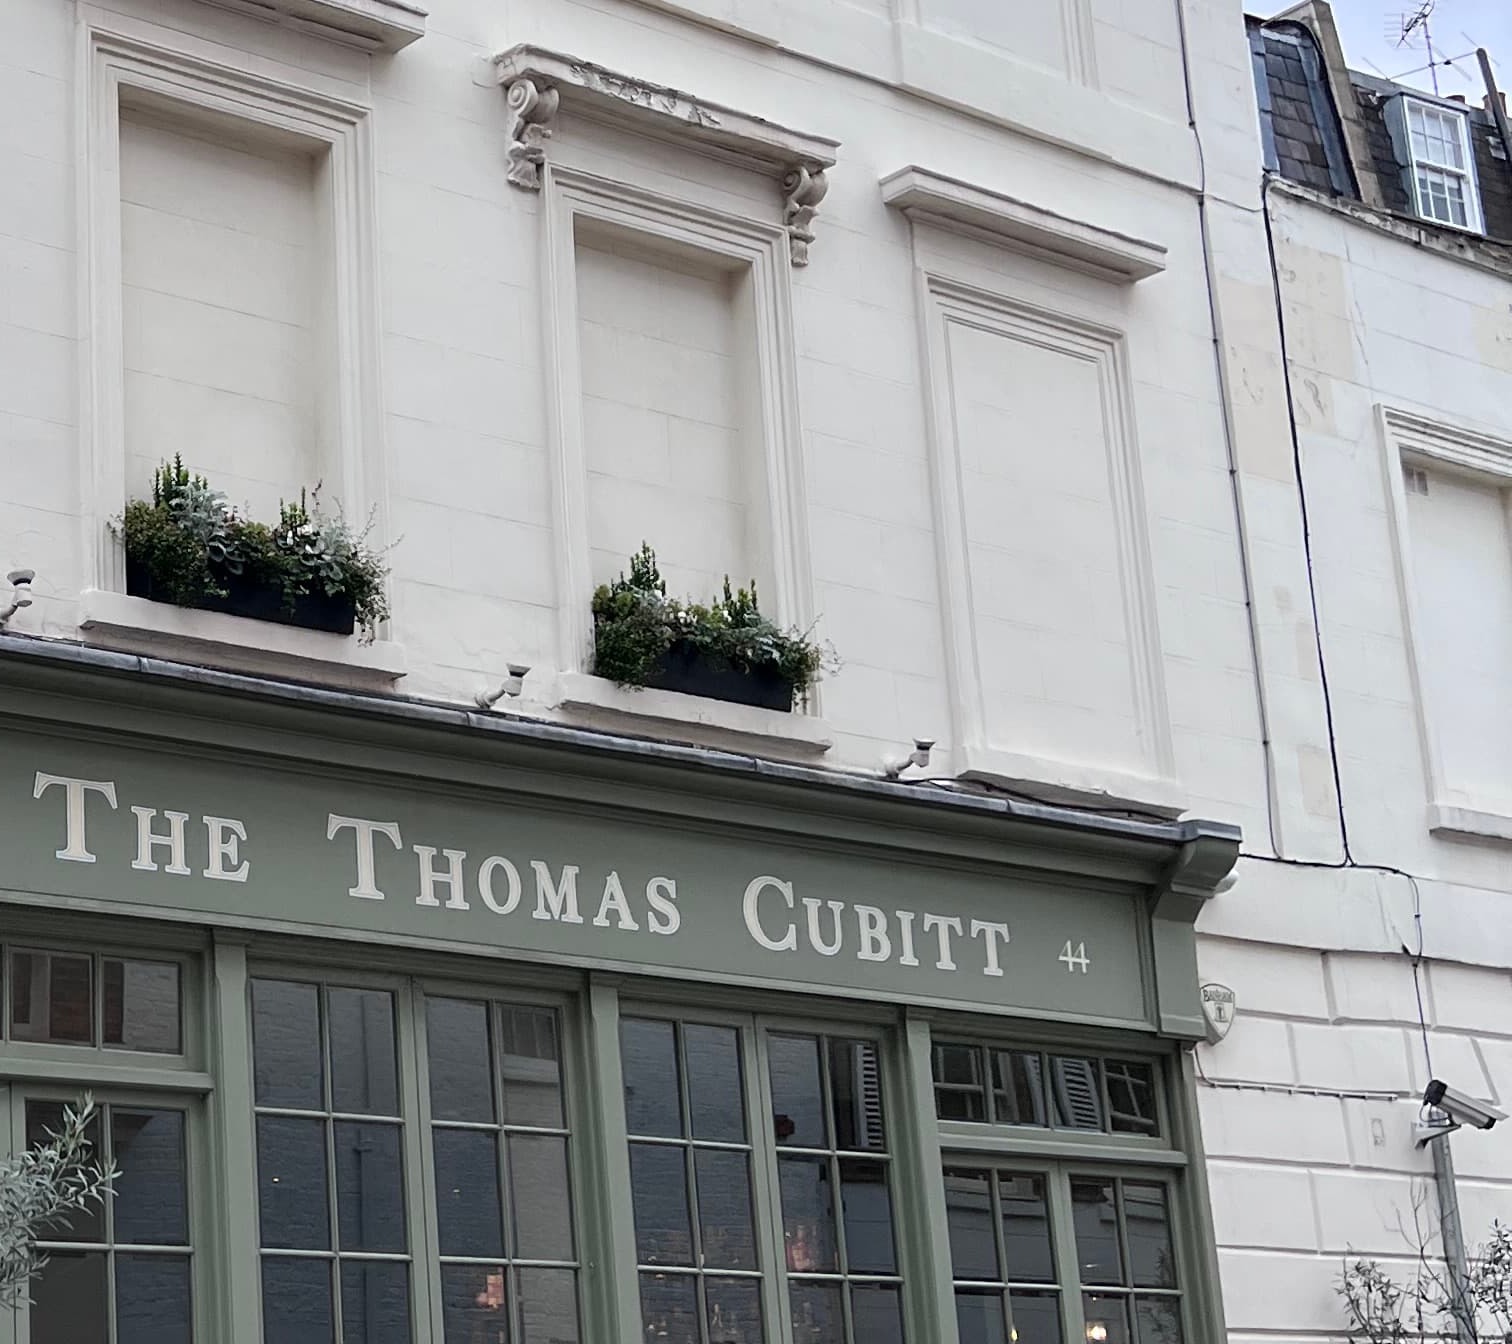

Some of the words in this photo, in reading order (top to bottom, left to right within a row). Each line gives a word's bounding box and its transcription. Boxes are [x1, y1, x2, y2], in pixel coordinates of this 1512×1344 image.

[33, 771, 251, 883] THE
[326, 813, 681, 935] THOMAS
[742, 875, 1010, 977] CUBITT
[1058, 940, 1091, 974] 44
